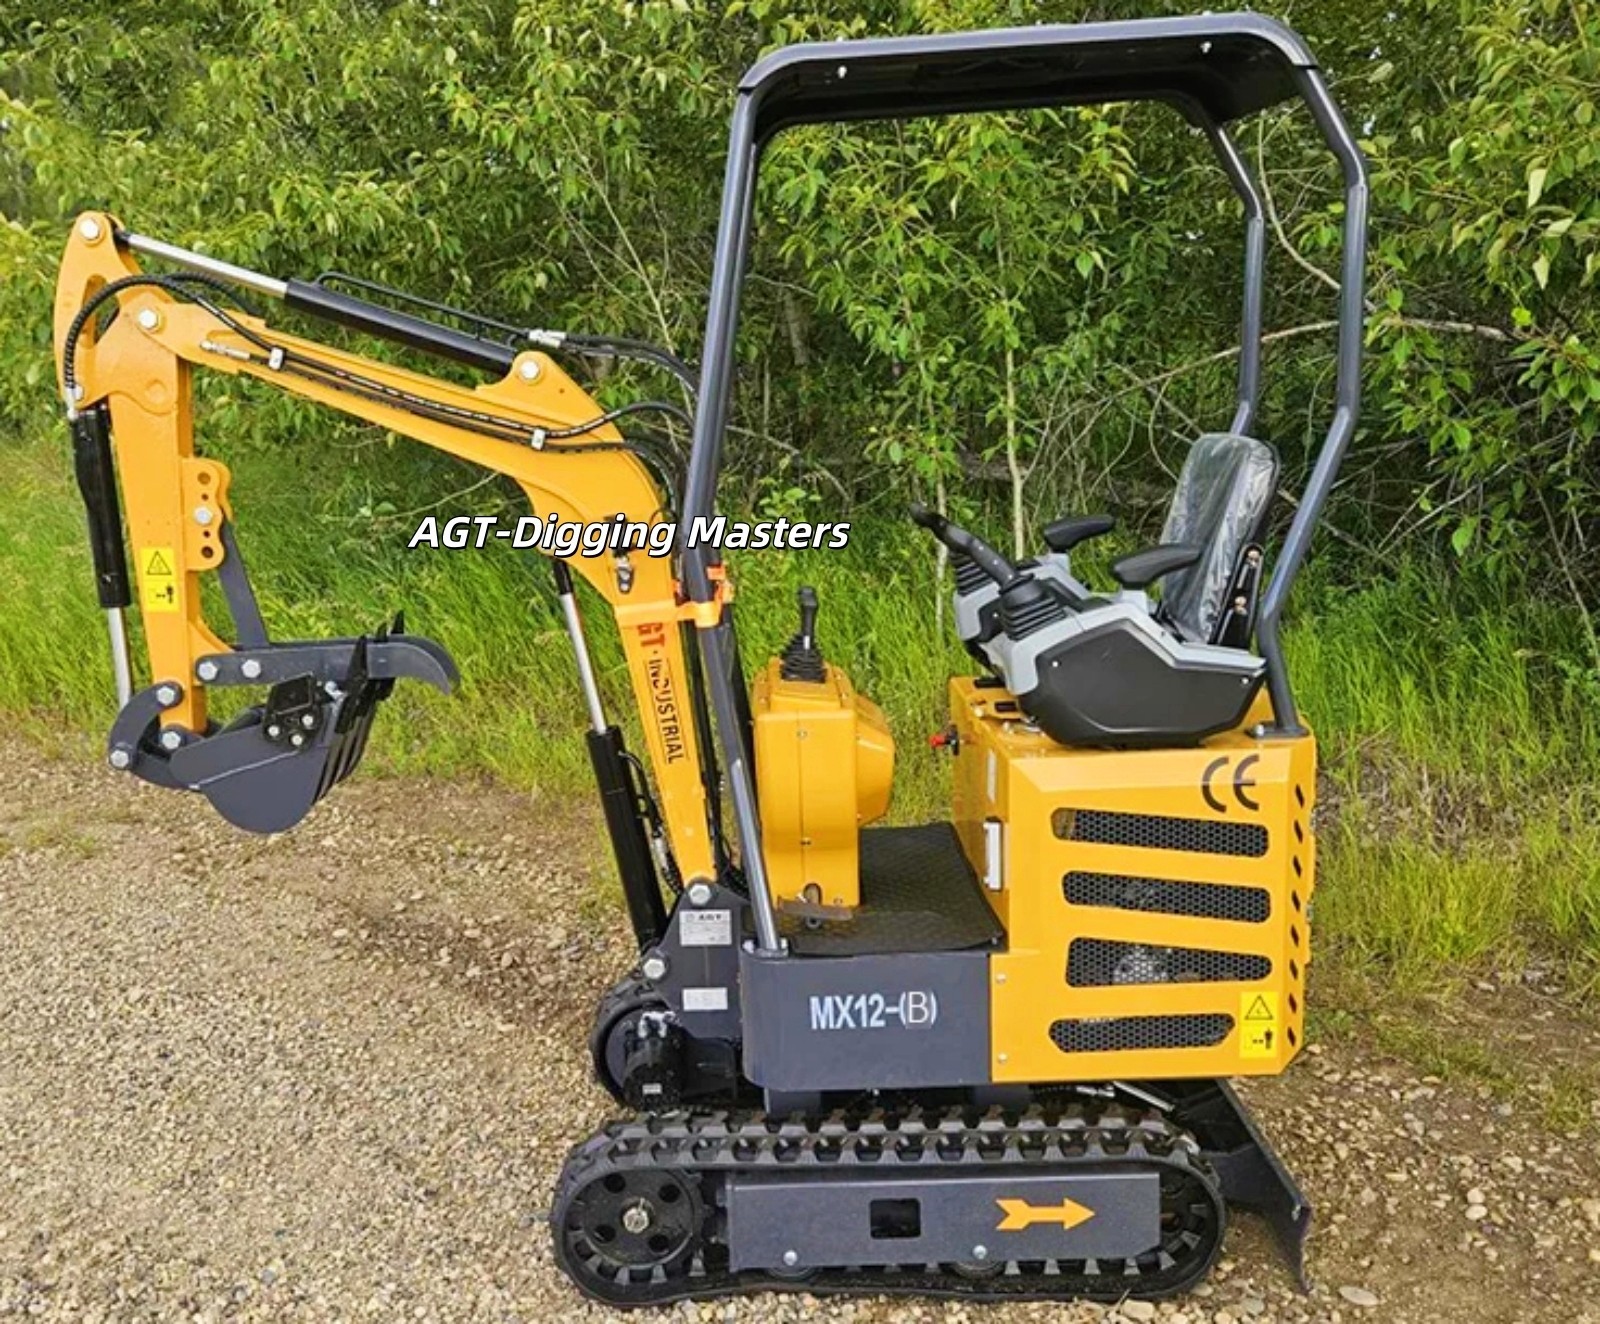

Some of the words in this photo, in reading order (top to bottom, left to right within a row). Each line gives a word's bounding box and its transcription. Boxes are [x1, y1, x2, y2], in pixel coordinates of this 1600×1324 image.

[637, 622, 666, 648] GT
[1201, 754, 1260, 813] CE
[809, 991, 937, 1030] MX12-(B)
